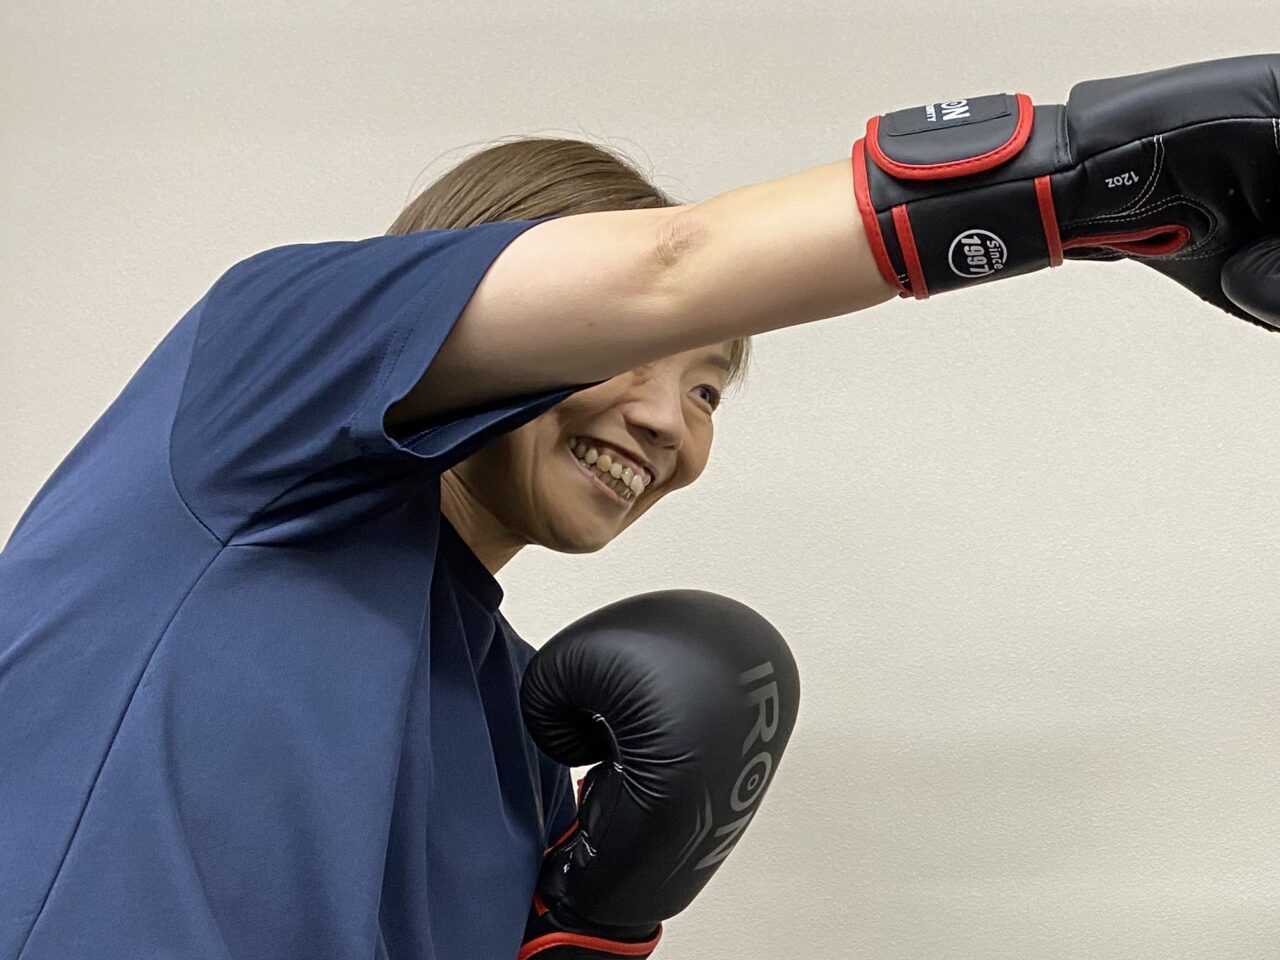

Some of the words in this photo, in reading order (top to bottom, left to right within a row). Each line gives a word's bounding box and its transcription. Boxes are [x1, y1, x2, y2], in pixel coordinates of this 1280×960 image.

[1105, 171, 1139, 188] 12oz
[961, 235, 990, 272] 1997
[987, 240, 1004, 270] Since
